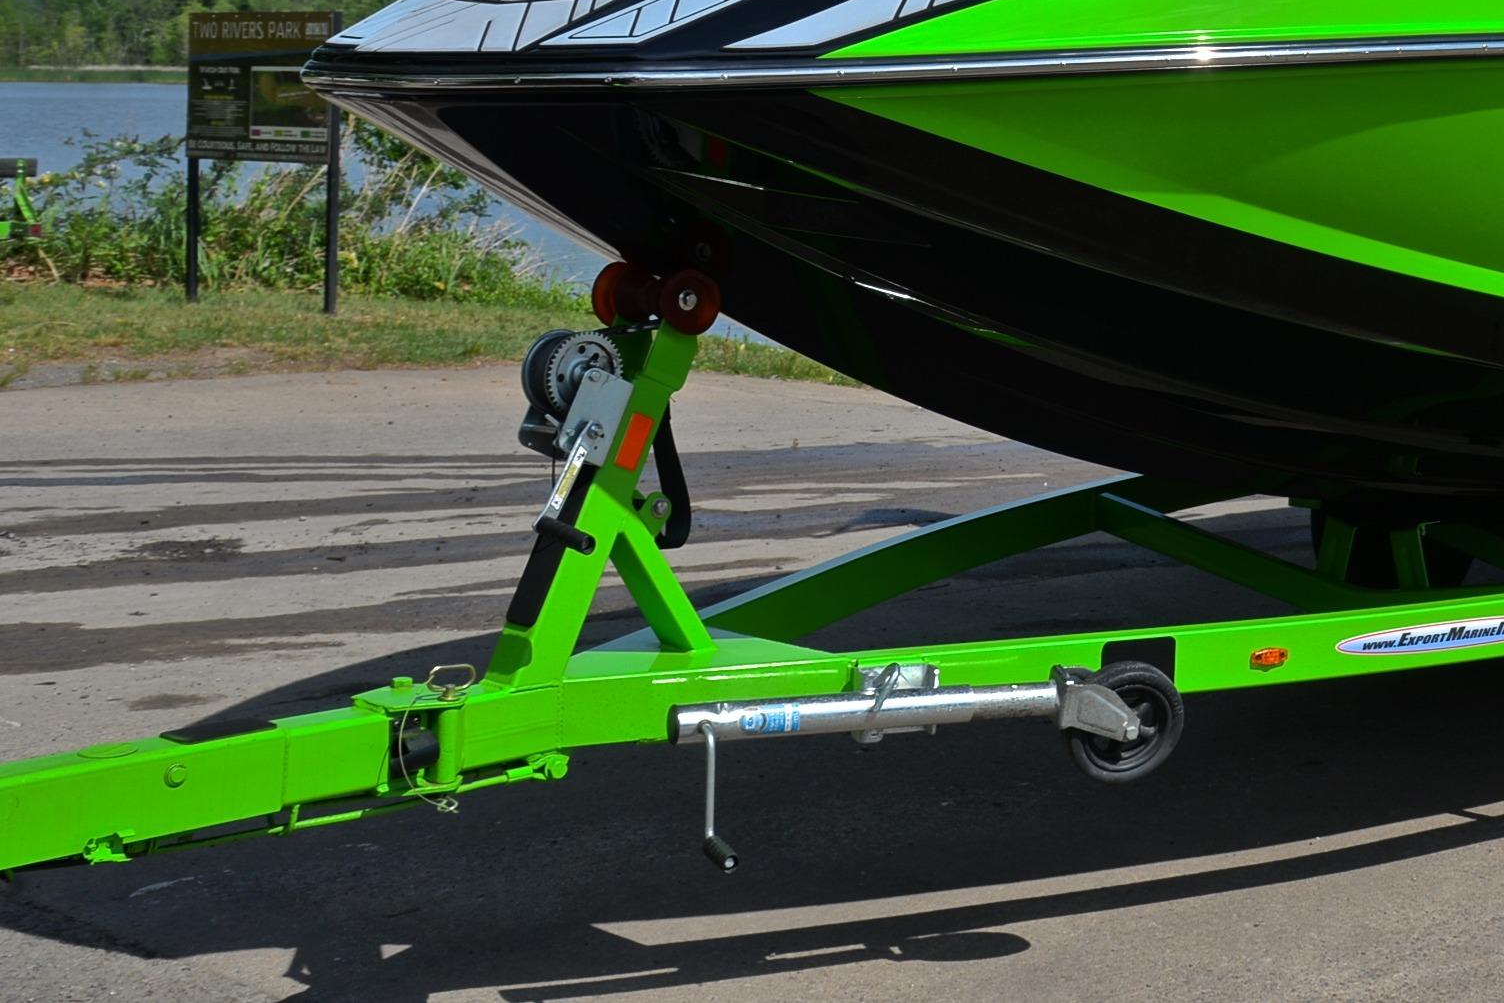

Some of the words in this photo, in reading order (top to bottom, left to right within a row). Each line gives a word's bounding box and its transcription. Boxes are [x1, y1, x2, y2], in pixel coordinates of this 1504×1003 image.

[192, 21, 218, 39] TWO
[222, 21, 264, 39] RIVERS
[267, 21, 302, 39] PARK
